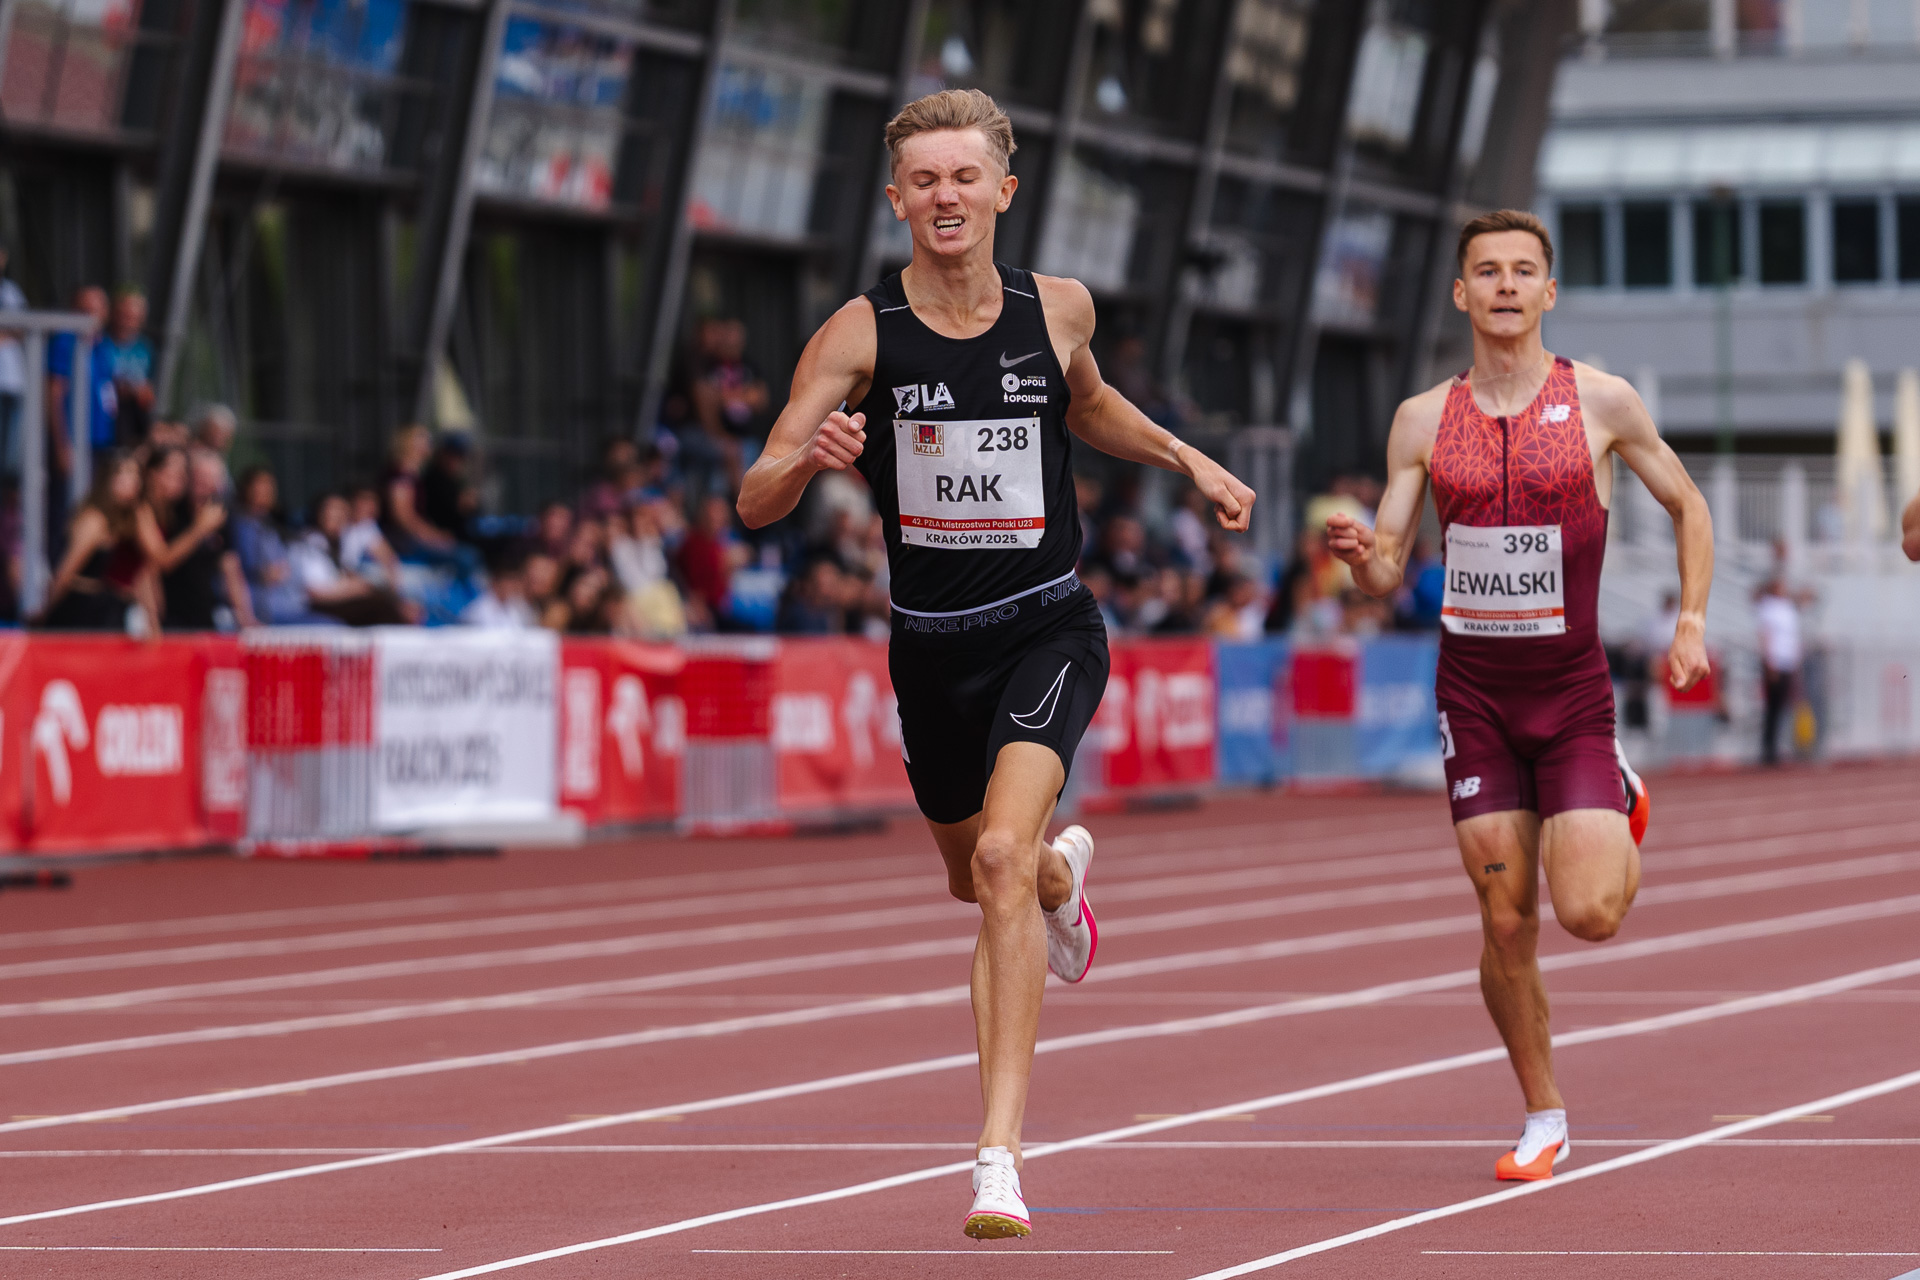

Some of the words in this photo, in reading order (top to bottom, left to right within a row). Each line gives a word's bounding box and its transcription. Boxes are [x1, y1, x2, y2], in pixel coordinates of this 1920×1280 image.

[1021, 379, 1047, 387] OPOLE
[1009, 394, 1048, 404] OPOLSKIE
[977, 426, 1029, 452] 238
[915, 444, 942, 455] MZLA
[936, 474, 1003, 502] RAK
[912, 518, 923, 526] 42.
[924, 519, 941, 528] PZLA
[942, 520, 991, 530] Mistrzostwa
[992, 519, 1017, 528] Polski
[1018, 519, 1034, 528] U23
[926, 532, 983, 545] KRAKÓW
[986, 534, 1018, 544] 2025
[1504, 533, 1549, 554] 398
[1450, 569, 1556, 596] LEWALSKI
[905, 616, 960, 632] NIKE
[964, 603, 1019, 631] PRO
[1464, 621, 1510, 632] KRAKÓW
[1513, 622, 1540, 631] 2025
